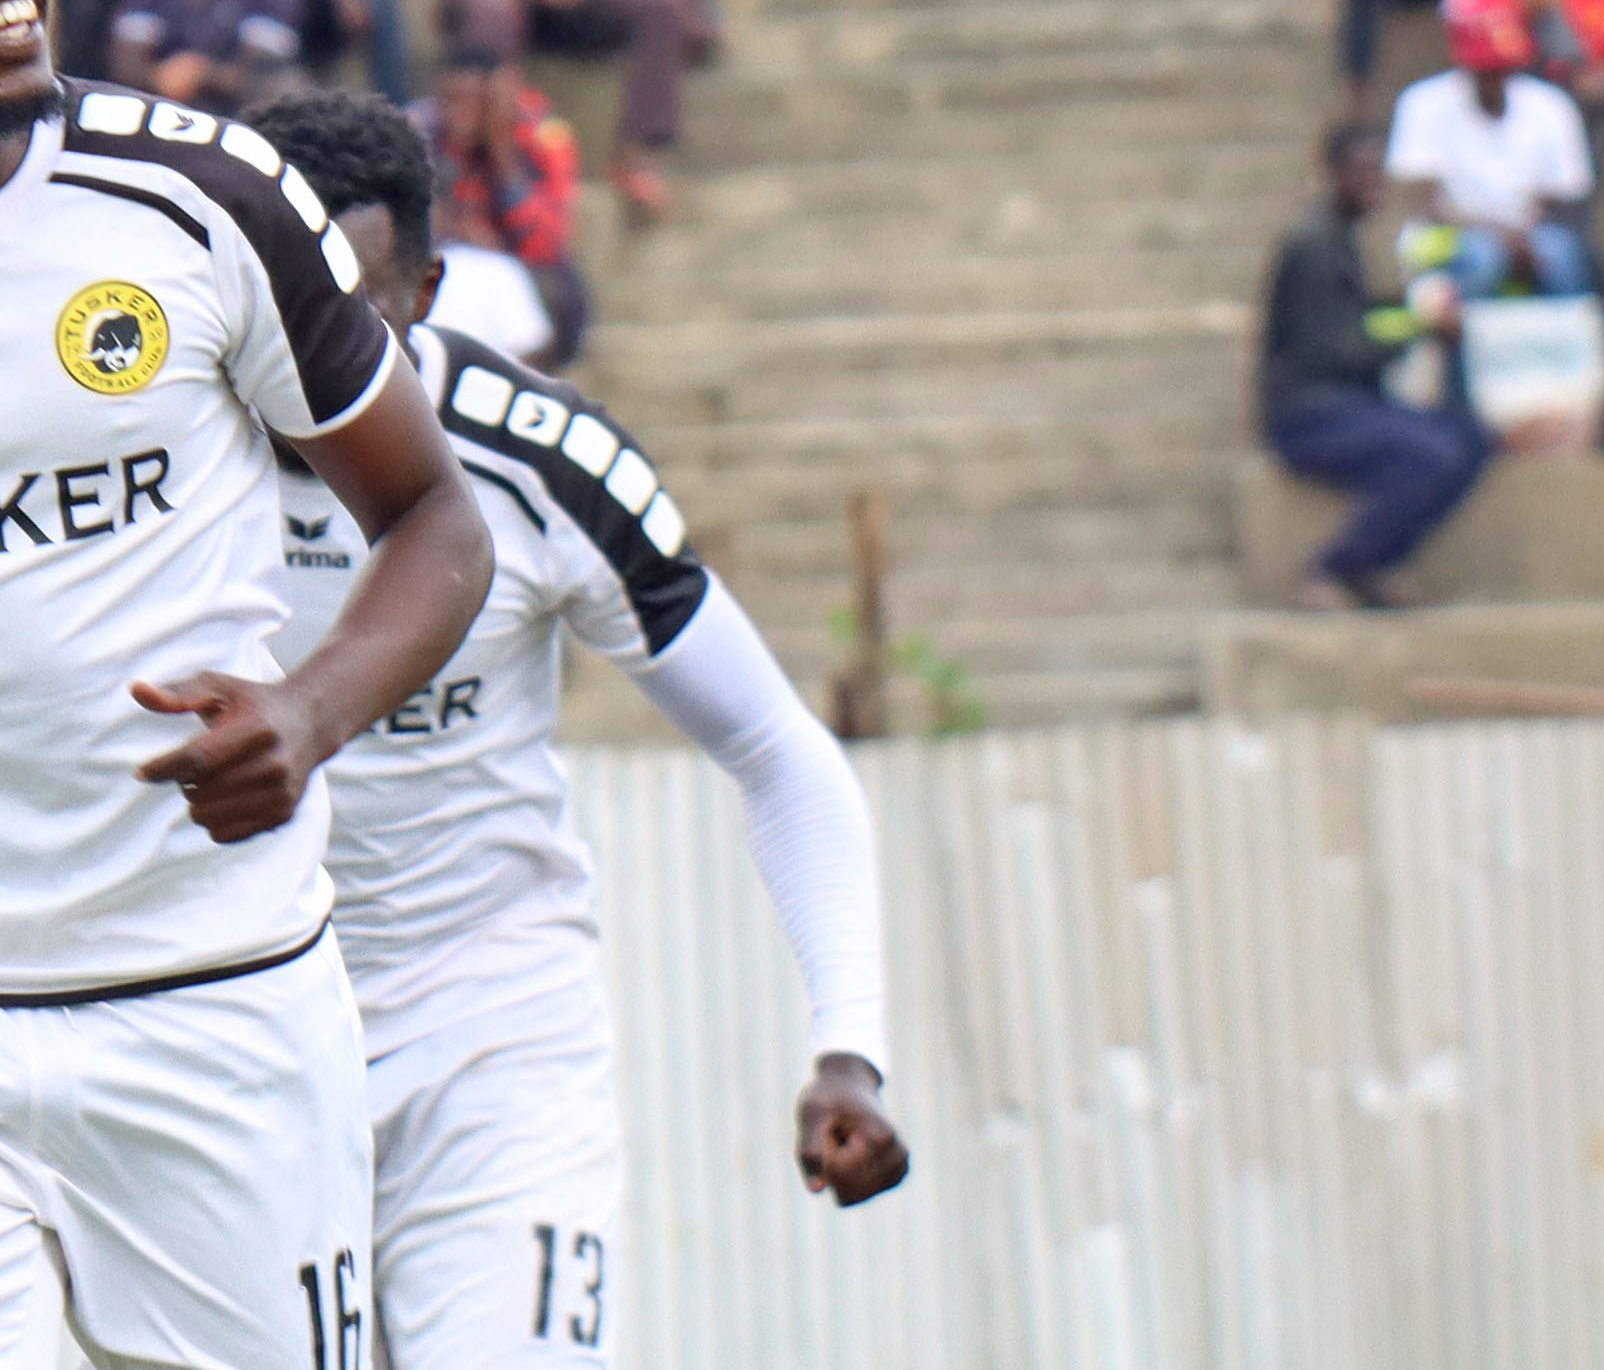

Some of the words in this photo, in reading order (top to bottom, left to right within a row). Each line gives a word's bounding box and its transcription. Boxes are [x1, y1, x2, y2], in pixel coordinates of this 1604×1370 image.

[64, 290, 159, 340] TUSKER
[285, 548, 350, 570] rima
[368, 675, 482, 734] ER
[531, 1221, 603, 1347] 13
